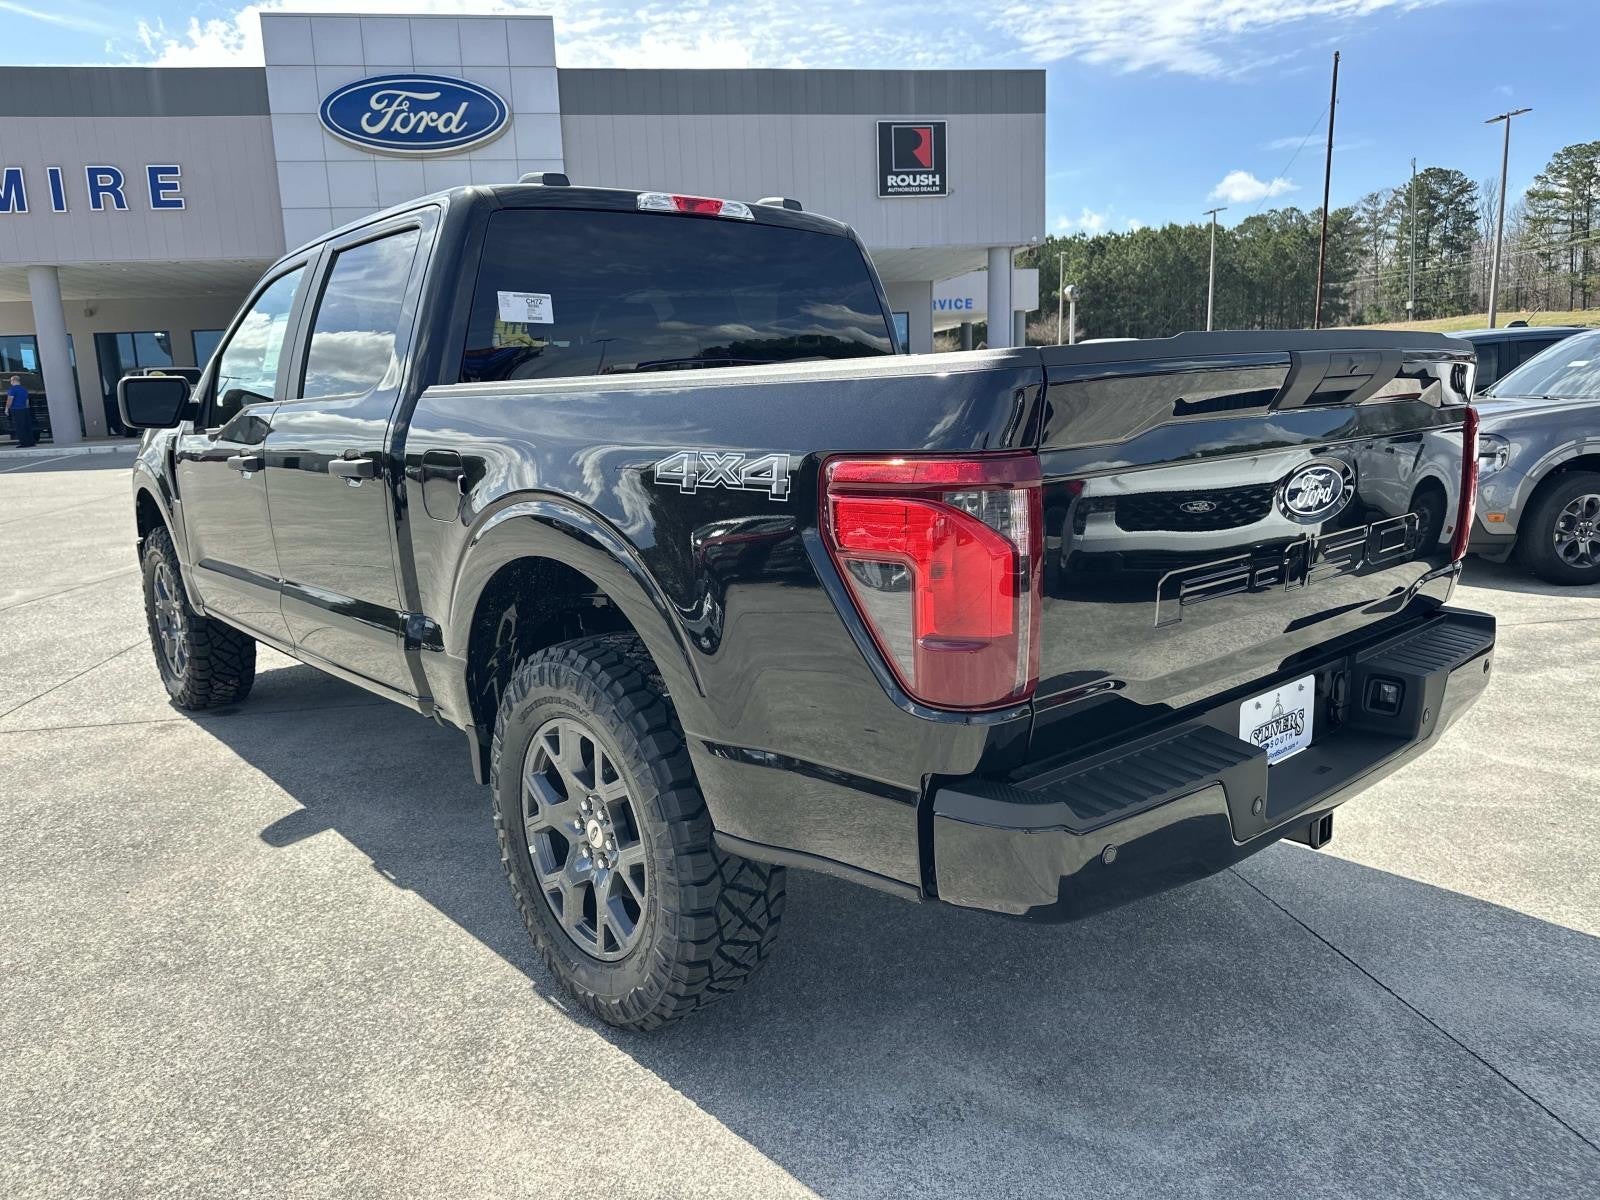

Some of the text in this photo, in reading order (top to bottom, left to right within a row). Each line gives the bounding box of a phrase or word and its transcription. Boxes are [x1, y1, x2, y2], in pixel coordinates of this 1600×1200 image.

[361, 89, 469, 134] Ford
[887, 174, 940, 186] ROUSH
[1296, 472, 1334, 508] Ford
[1154, 512, 1420, 629] F-150
[1250, 708, 1305, 747] STIVERS
[1270, 733, 1292, 748] SOUTH
